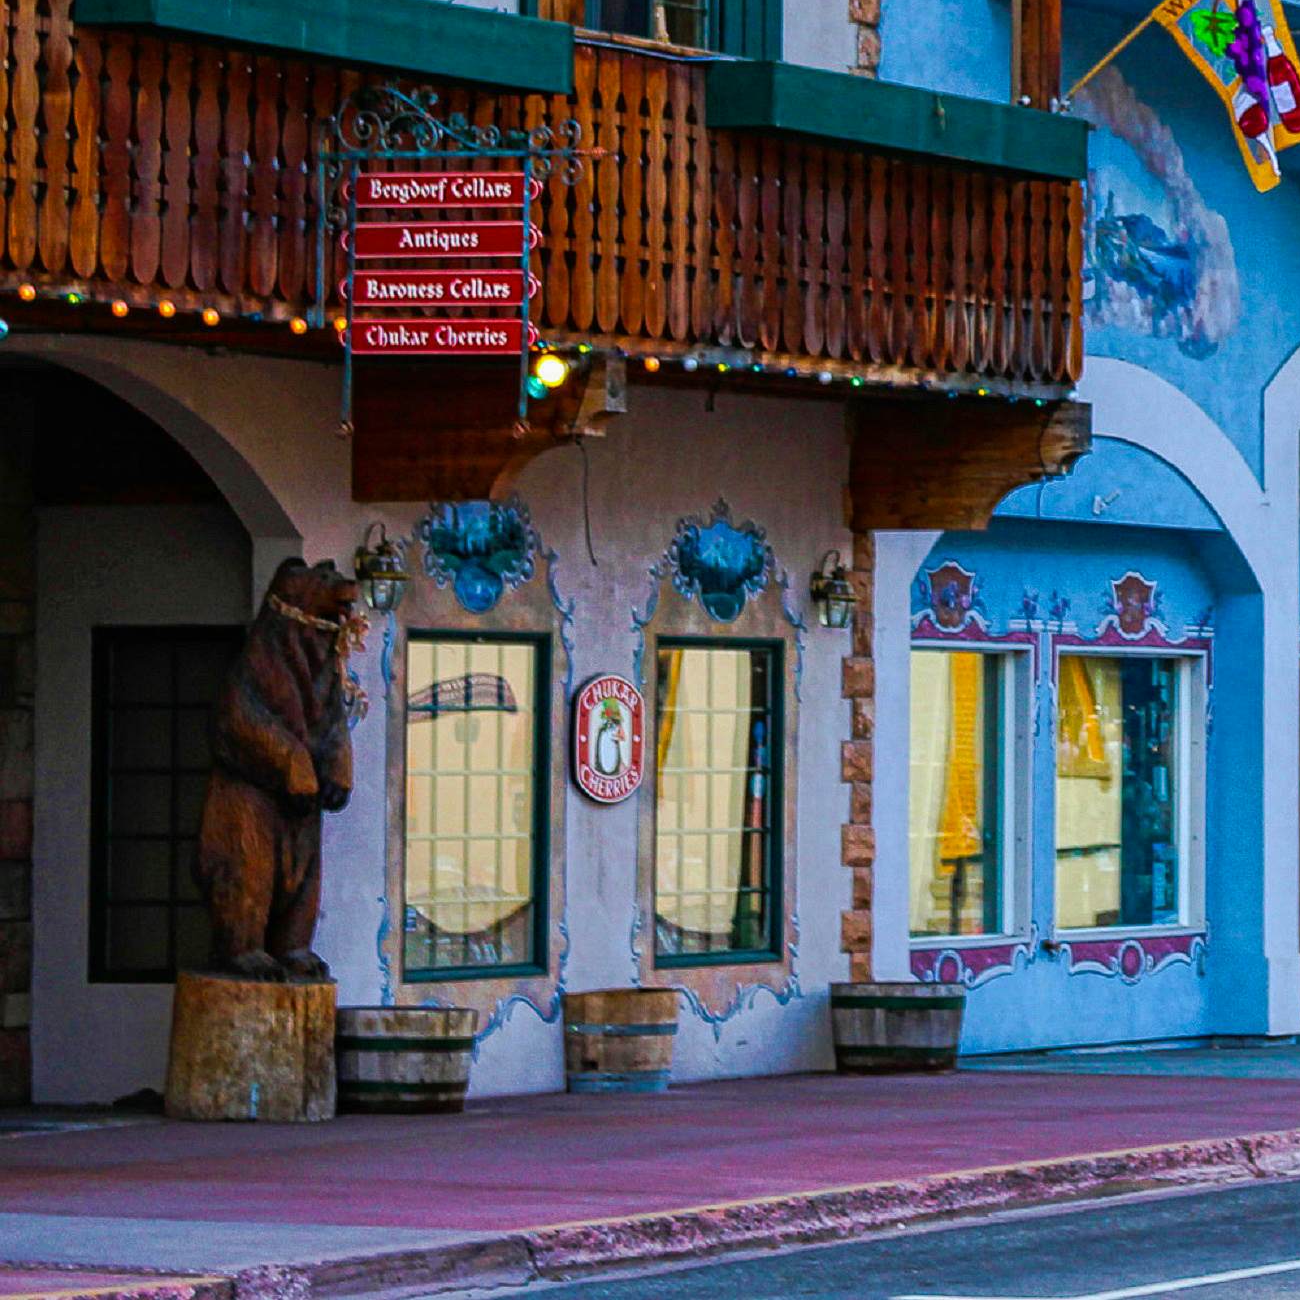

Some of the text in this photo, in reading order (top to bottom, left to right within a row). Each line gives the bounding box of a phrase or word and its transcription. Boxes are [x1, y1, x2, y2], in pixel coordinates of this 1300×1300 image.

[370, 178, 512, 203] Bergdorf Cellars
[399, 229, 479, 251] Antiques
[366, 278, 511, 299] Baroness Cellars
[366, 325, 508, 347] Chukar Cherries
[583, 680, 639, 712] CHUKAR
[580, 763, 640, 797] CHERRIES
